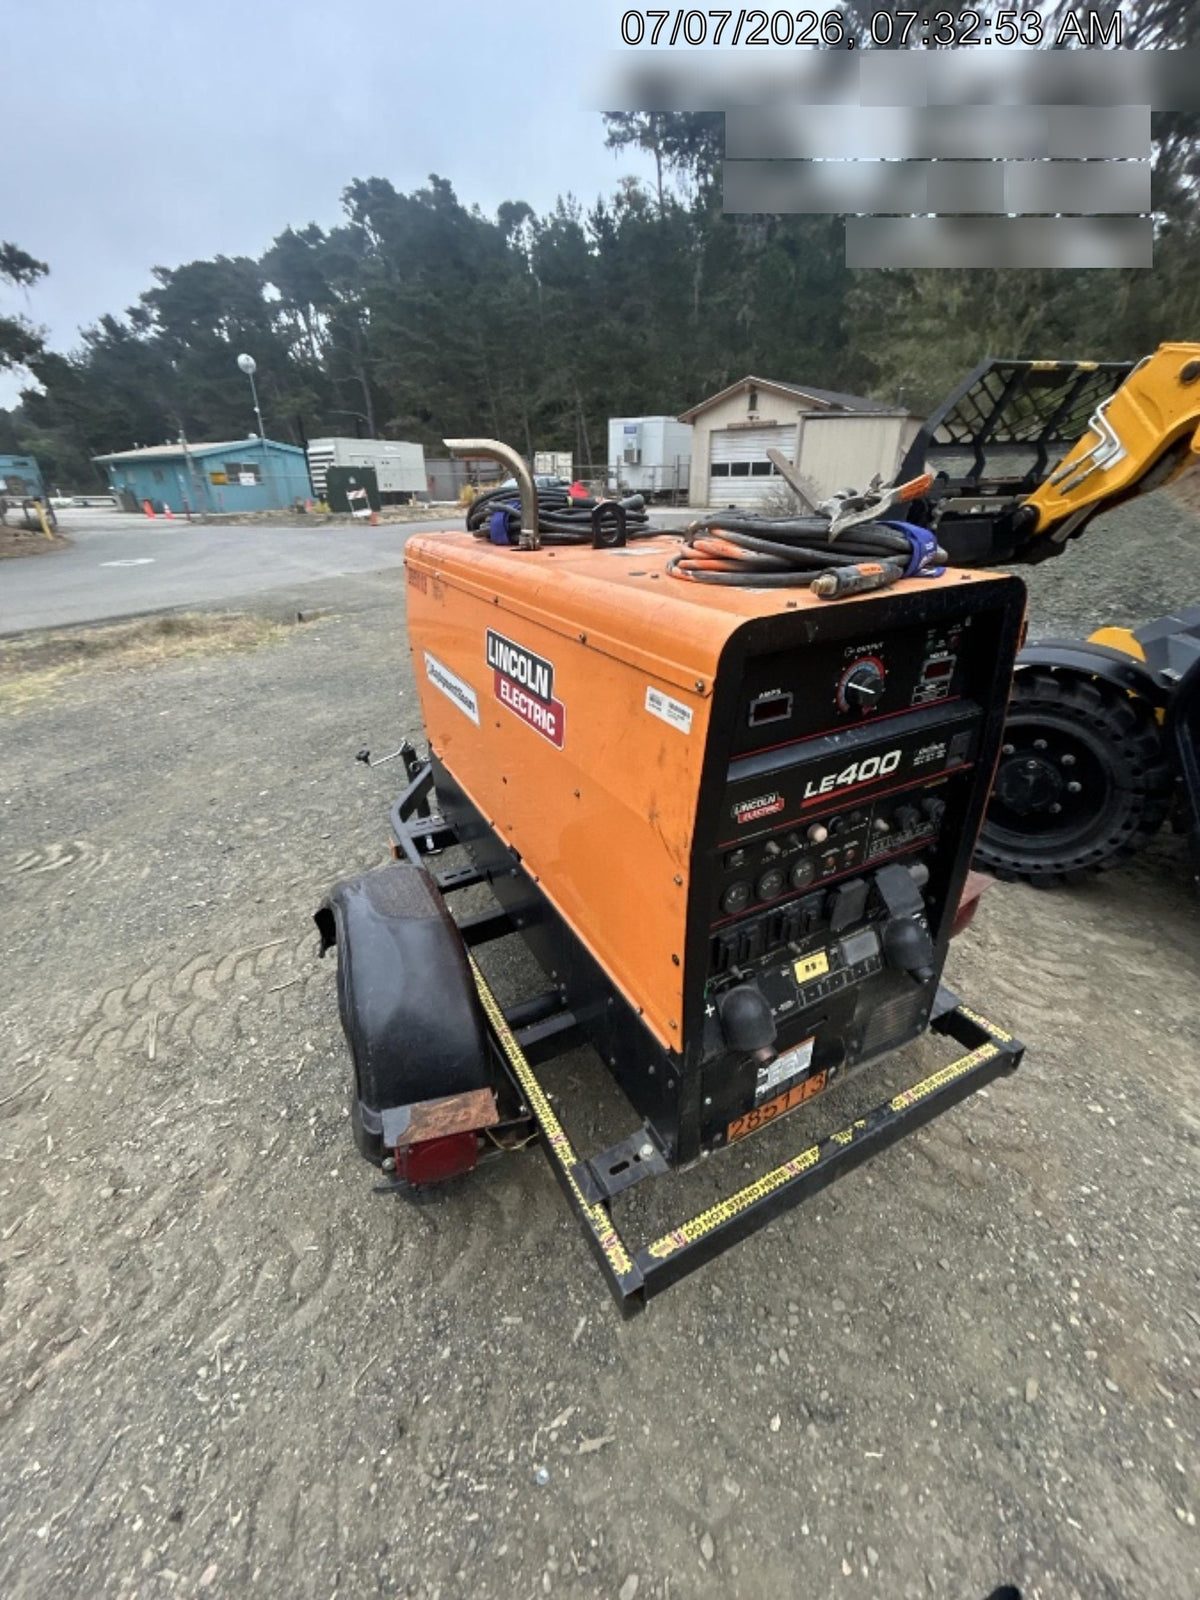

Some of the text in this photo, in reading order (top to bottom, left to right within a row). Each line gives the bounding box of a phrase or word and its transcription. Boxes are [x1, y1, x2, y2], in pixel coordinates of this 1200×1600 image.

[488, 635, 549, 699] LINCOLN
[500, 679, 556, 736] ELECTRIC
[803, 749, 902, 799] LE400
[734, 794, 776, 816] LINCOLN
[685, 1171, 787, 1238] DO NOT STAND HERE
